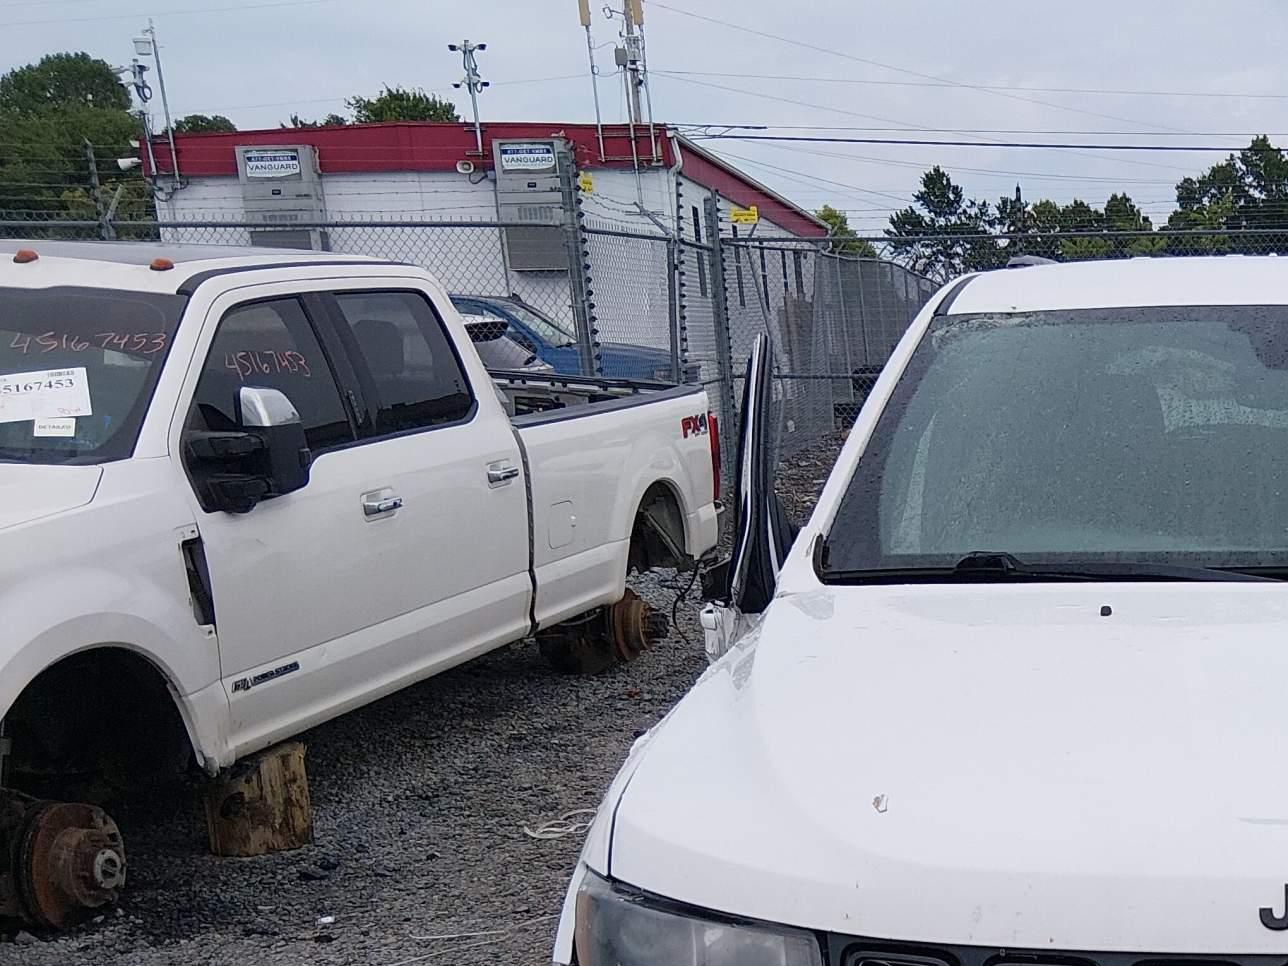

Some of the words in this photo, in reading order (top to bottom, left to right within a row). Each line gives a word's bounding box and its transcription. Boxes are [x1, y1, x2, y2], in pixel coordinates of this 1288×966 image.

[247, 163, 298, 171] VANGUARD
[225, 350, 311, 381] 45167453
[0, 379, 74, 394] 5167453
[681, 413, 708, 439] FX4
